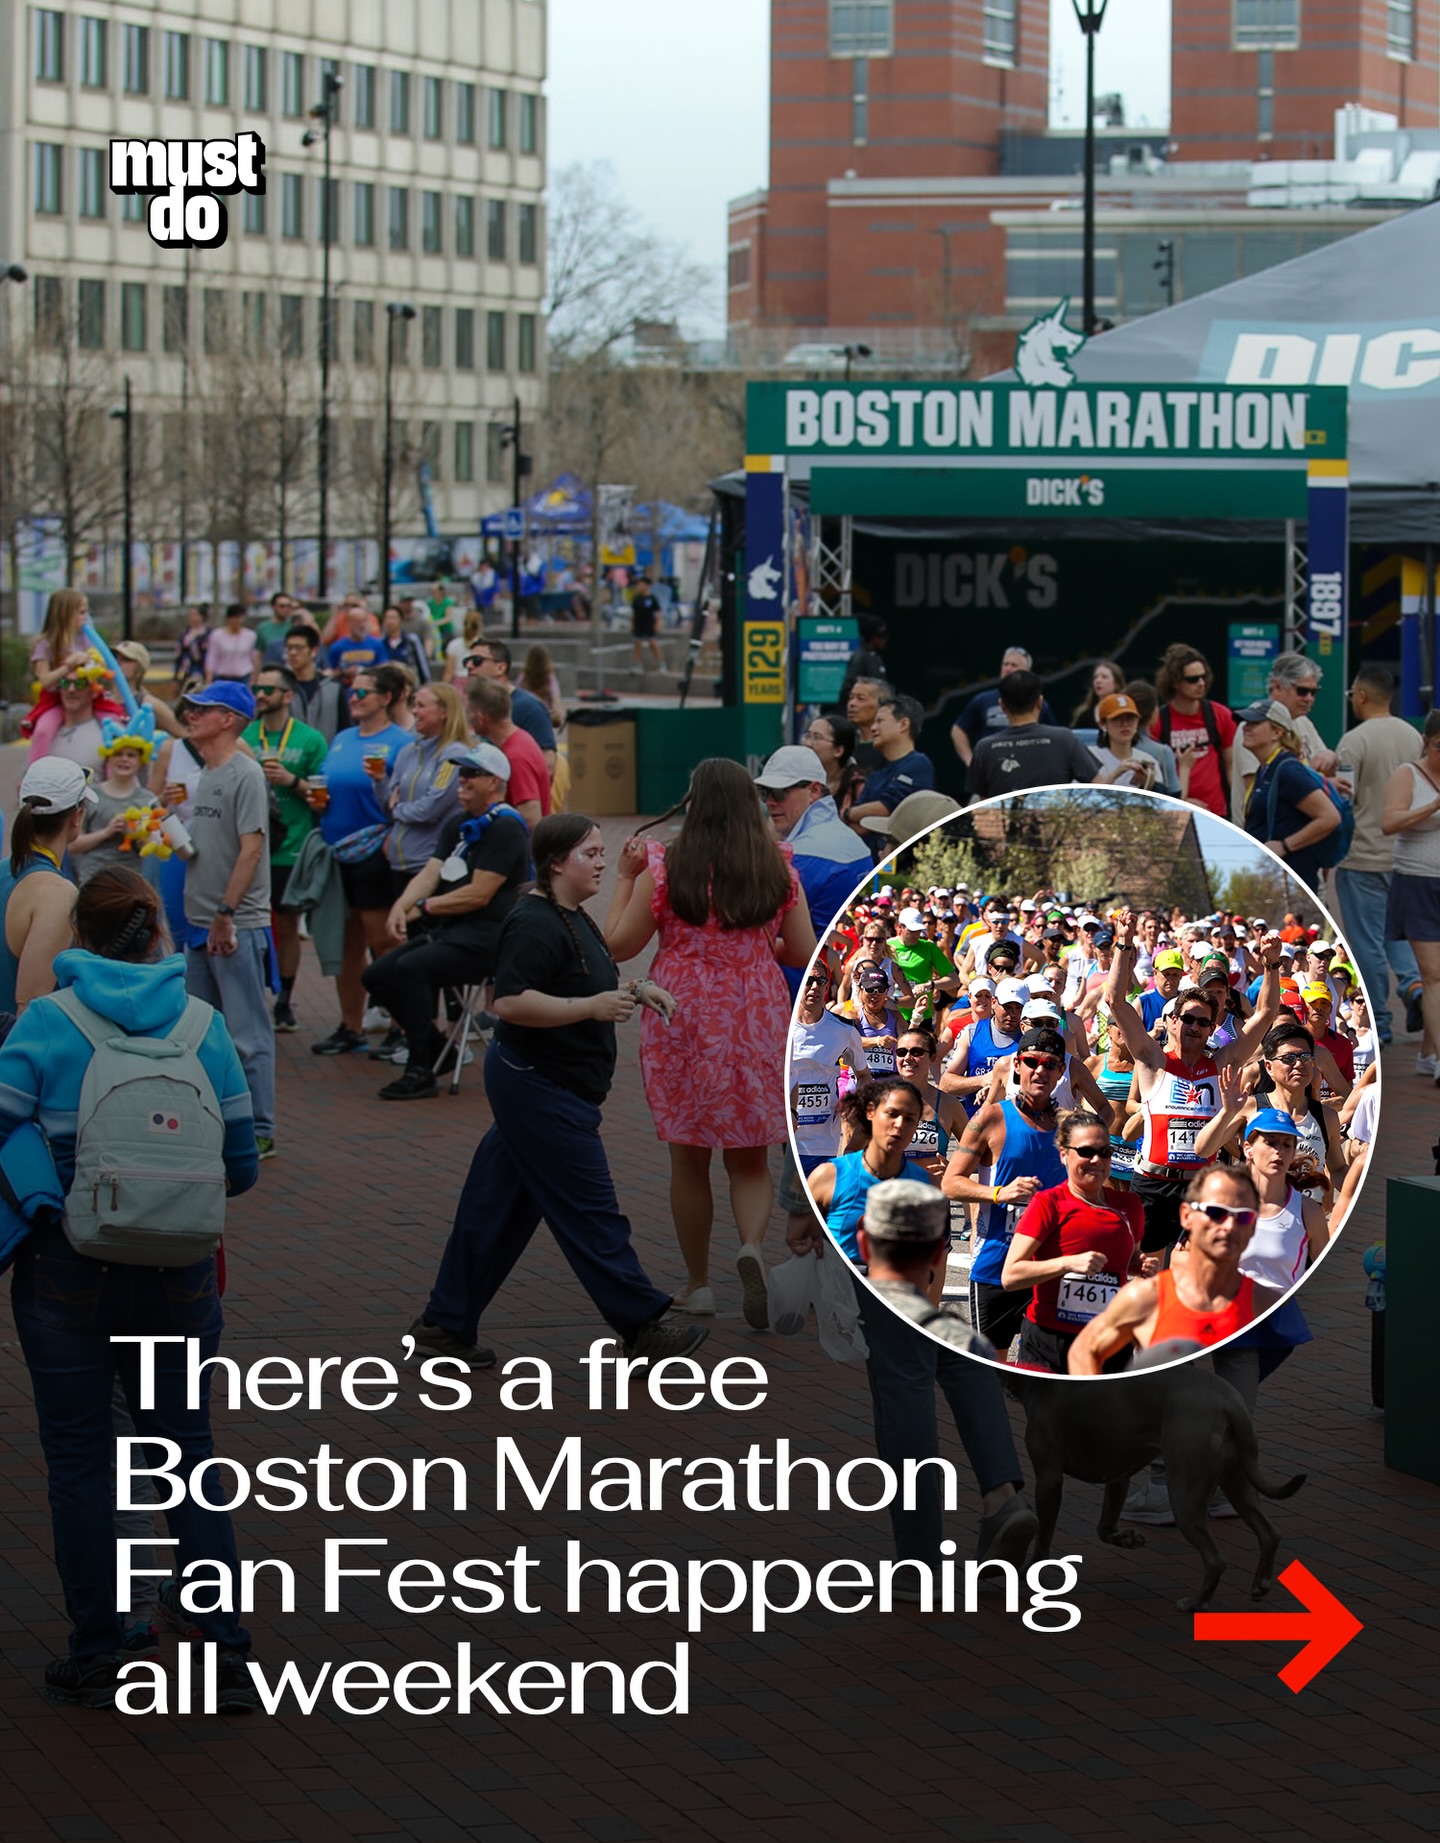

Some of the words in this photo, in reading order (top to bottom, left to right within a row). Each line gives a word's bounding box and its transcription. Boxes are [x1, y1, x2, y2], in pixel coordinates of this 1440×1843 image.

[786, 390, 993, 447] BOSTON
[1009, 391, 1305, 449] MARATHON
[1027, 476, 1104, 506] DICK'S
[896, 548, 1058, 608] DICK'S
[1310, 572, 1341, 636] 1897
[749, 629, 780, 681] 129
[749, 683, 780, 695] YEARS
[867, 1053, 893, 1065] 4816
[798, 1095, 829, 1108] 4551
